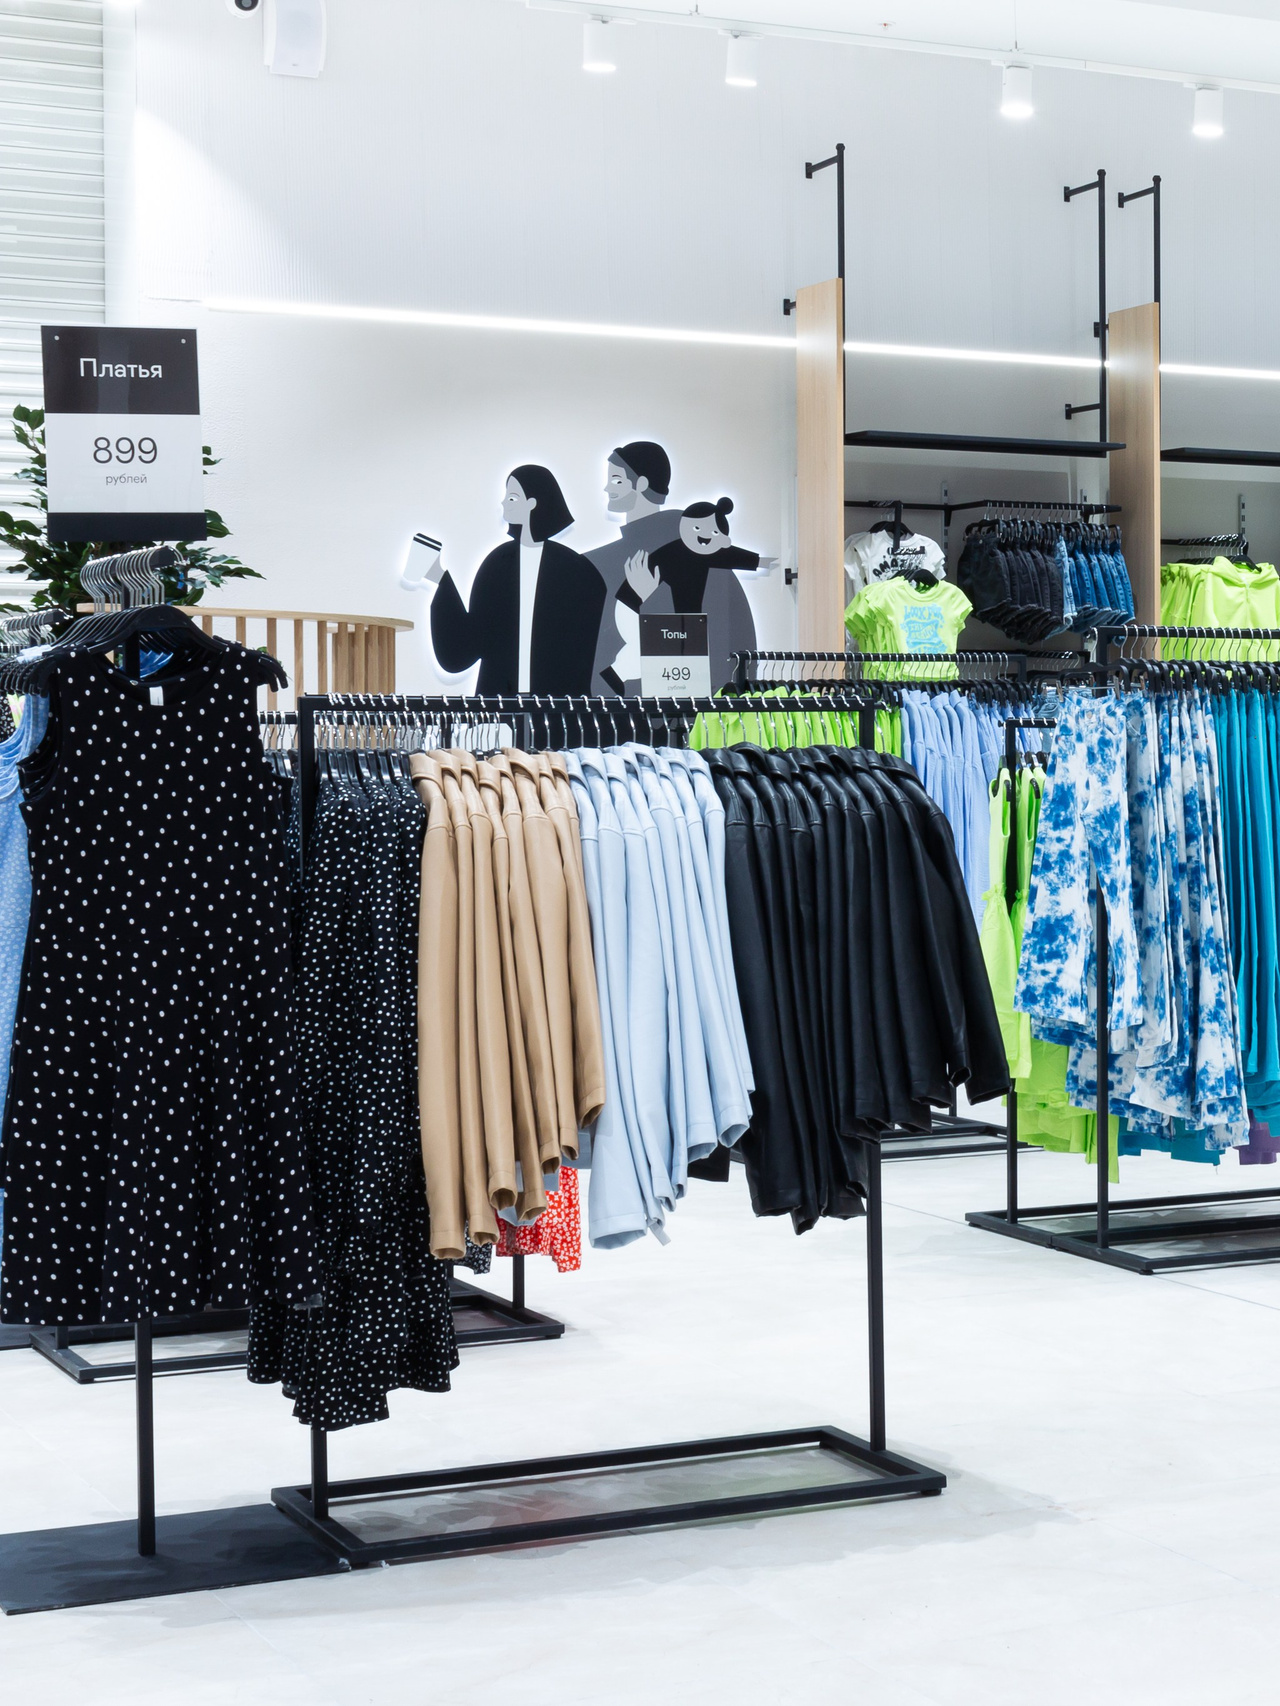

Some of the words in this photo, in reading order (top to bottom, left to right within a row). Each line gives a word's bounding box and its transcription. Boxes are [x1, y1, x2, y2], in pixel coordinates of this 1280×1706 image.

[79, 357, 163, 378] Платья
[93, 436, 158, 464] 899
[105, 474, 148, 486] рублей
[660, 629, 688, 639] Топы
[662, 667, 691, 681] 499
